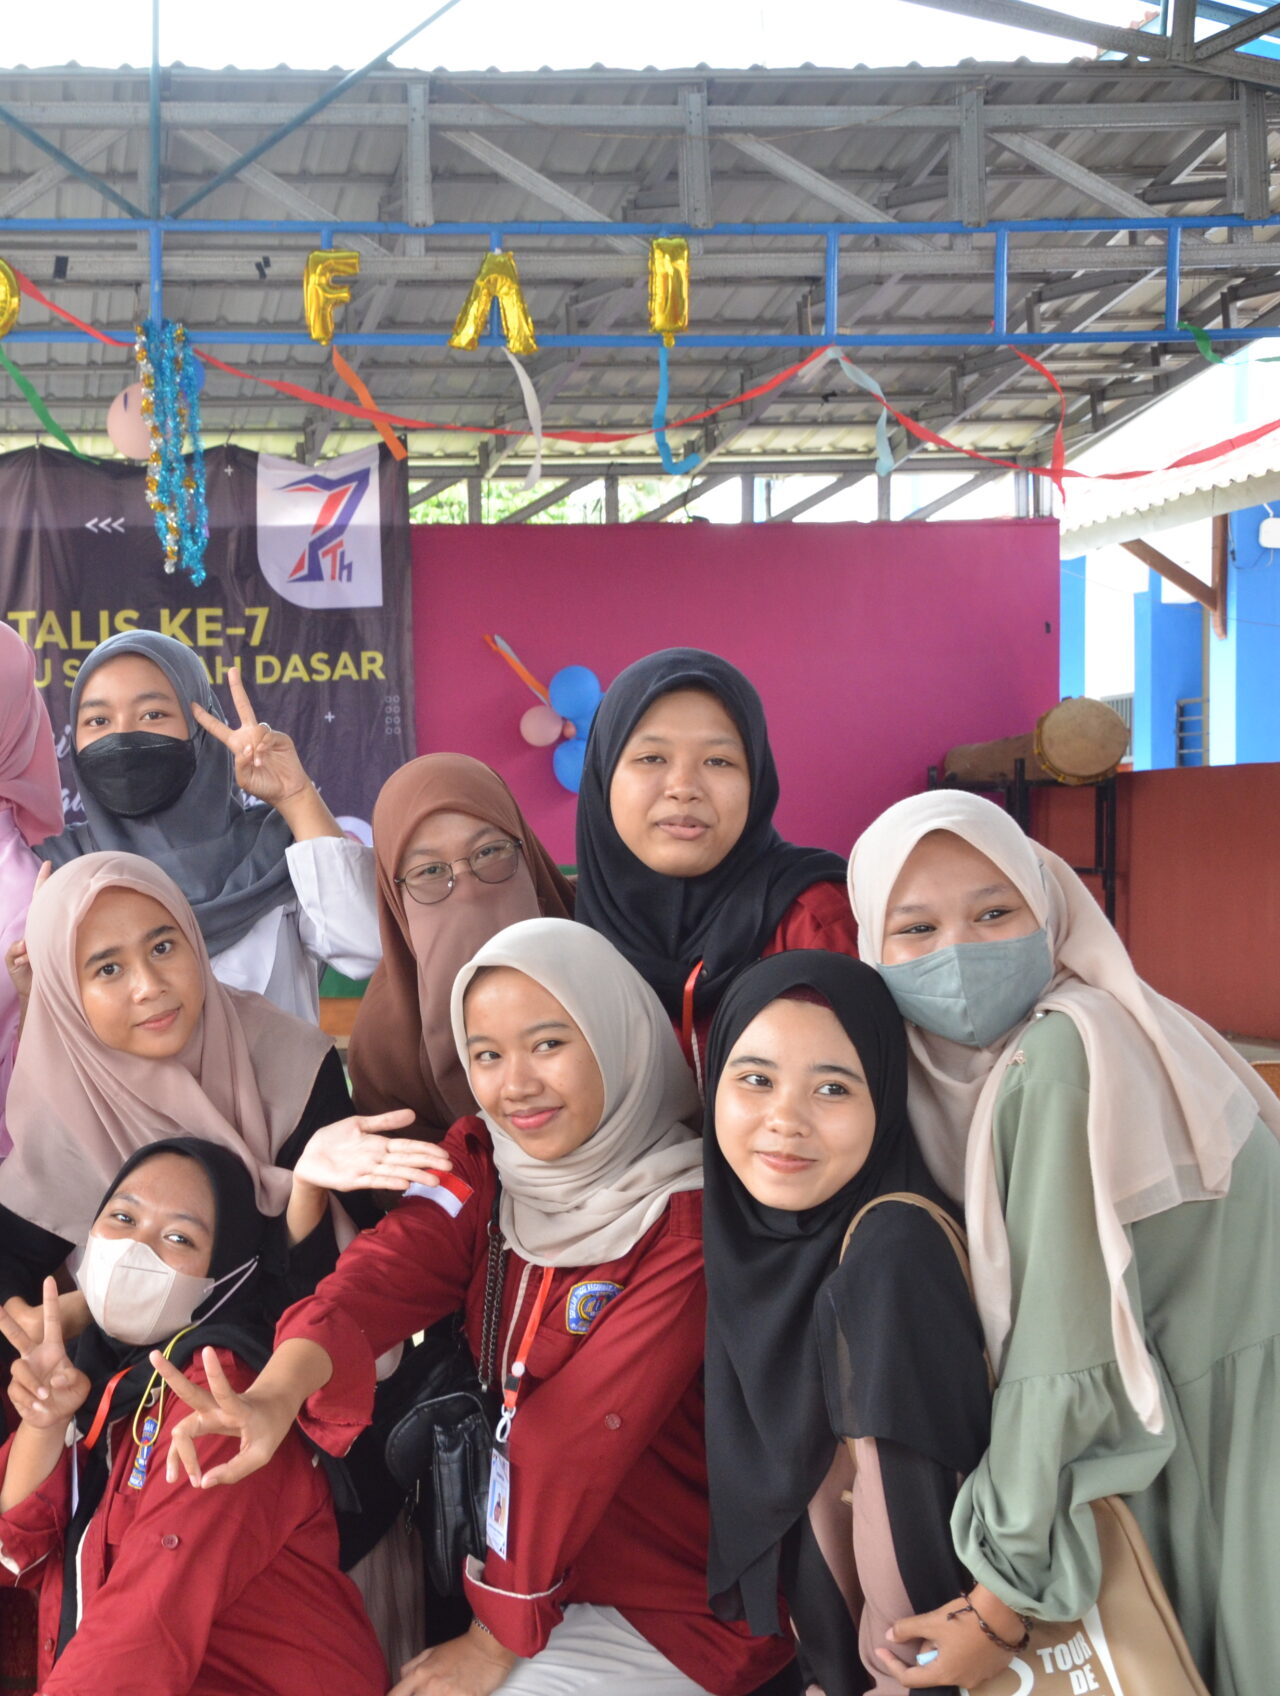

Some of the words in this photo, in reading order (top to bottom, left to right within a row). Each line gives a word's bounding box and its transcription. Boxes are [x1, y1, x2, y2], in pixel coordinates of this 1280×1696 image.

[159, 606, 271, 648] KE-7
[254, 650, 387, 684] DASAR
[1035, 1631, 1092, 1675] TOUR
[1068, 1663, 1100, 1695] DE
